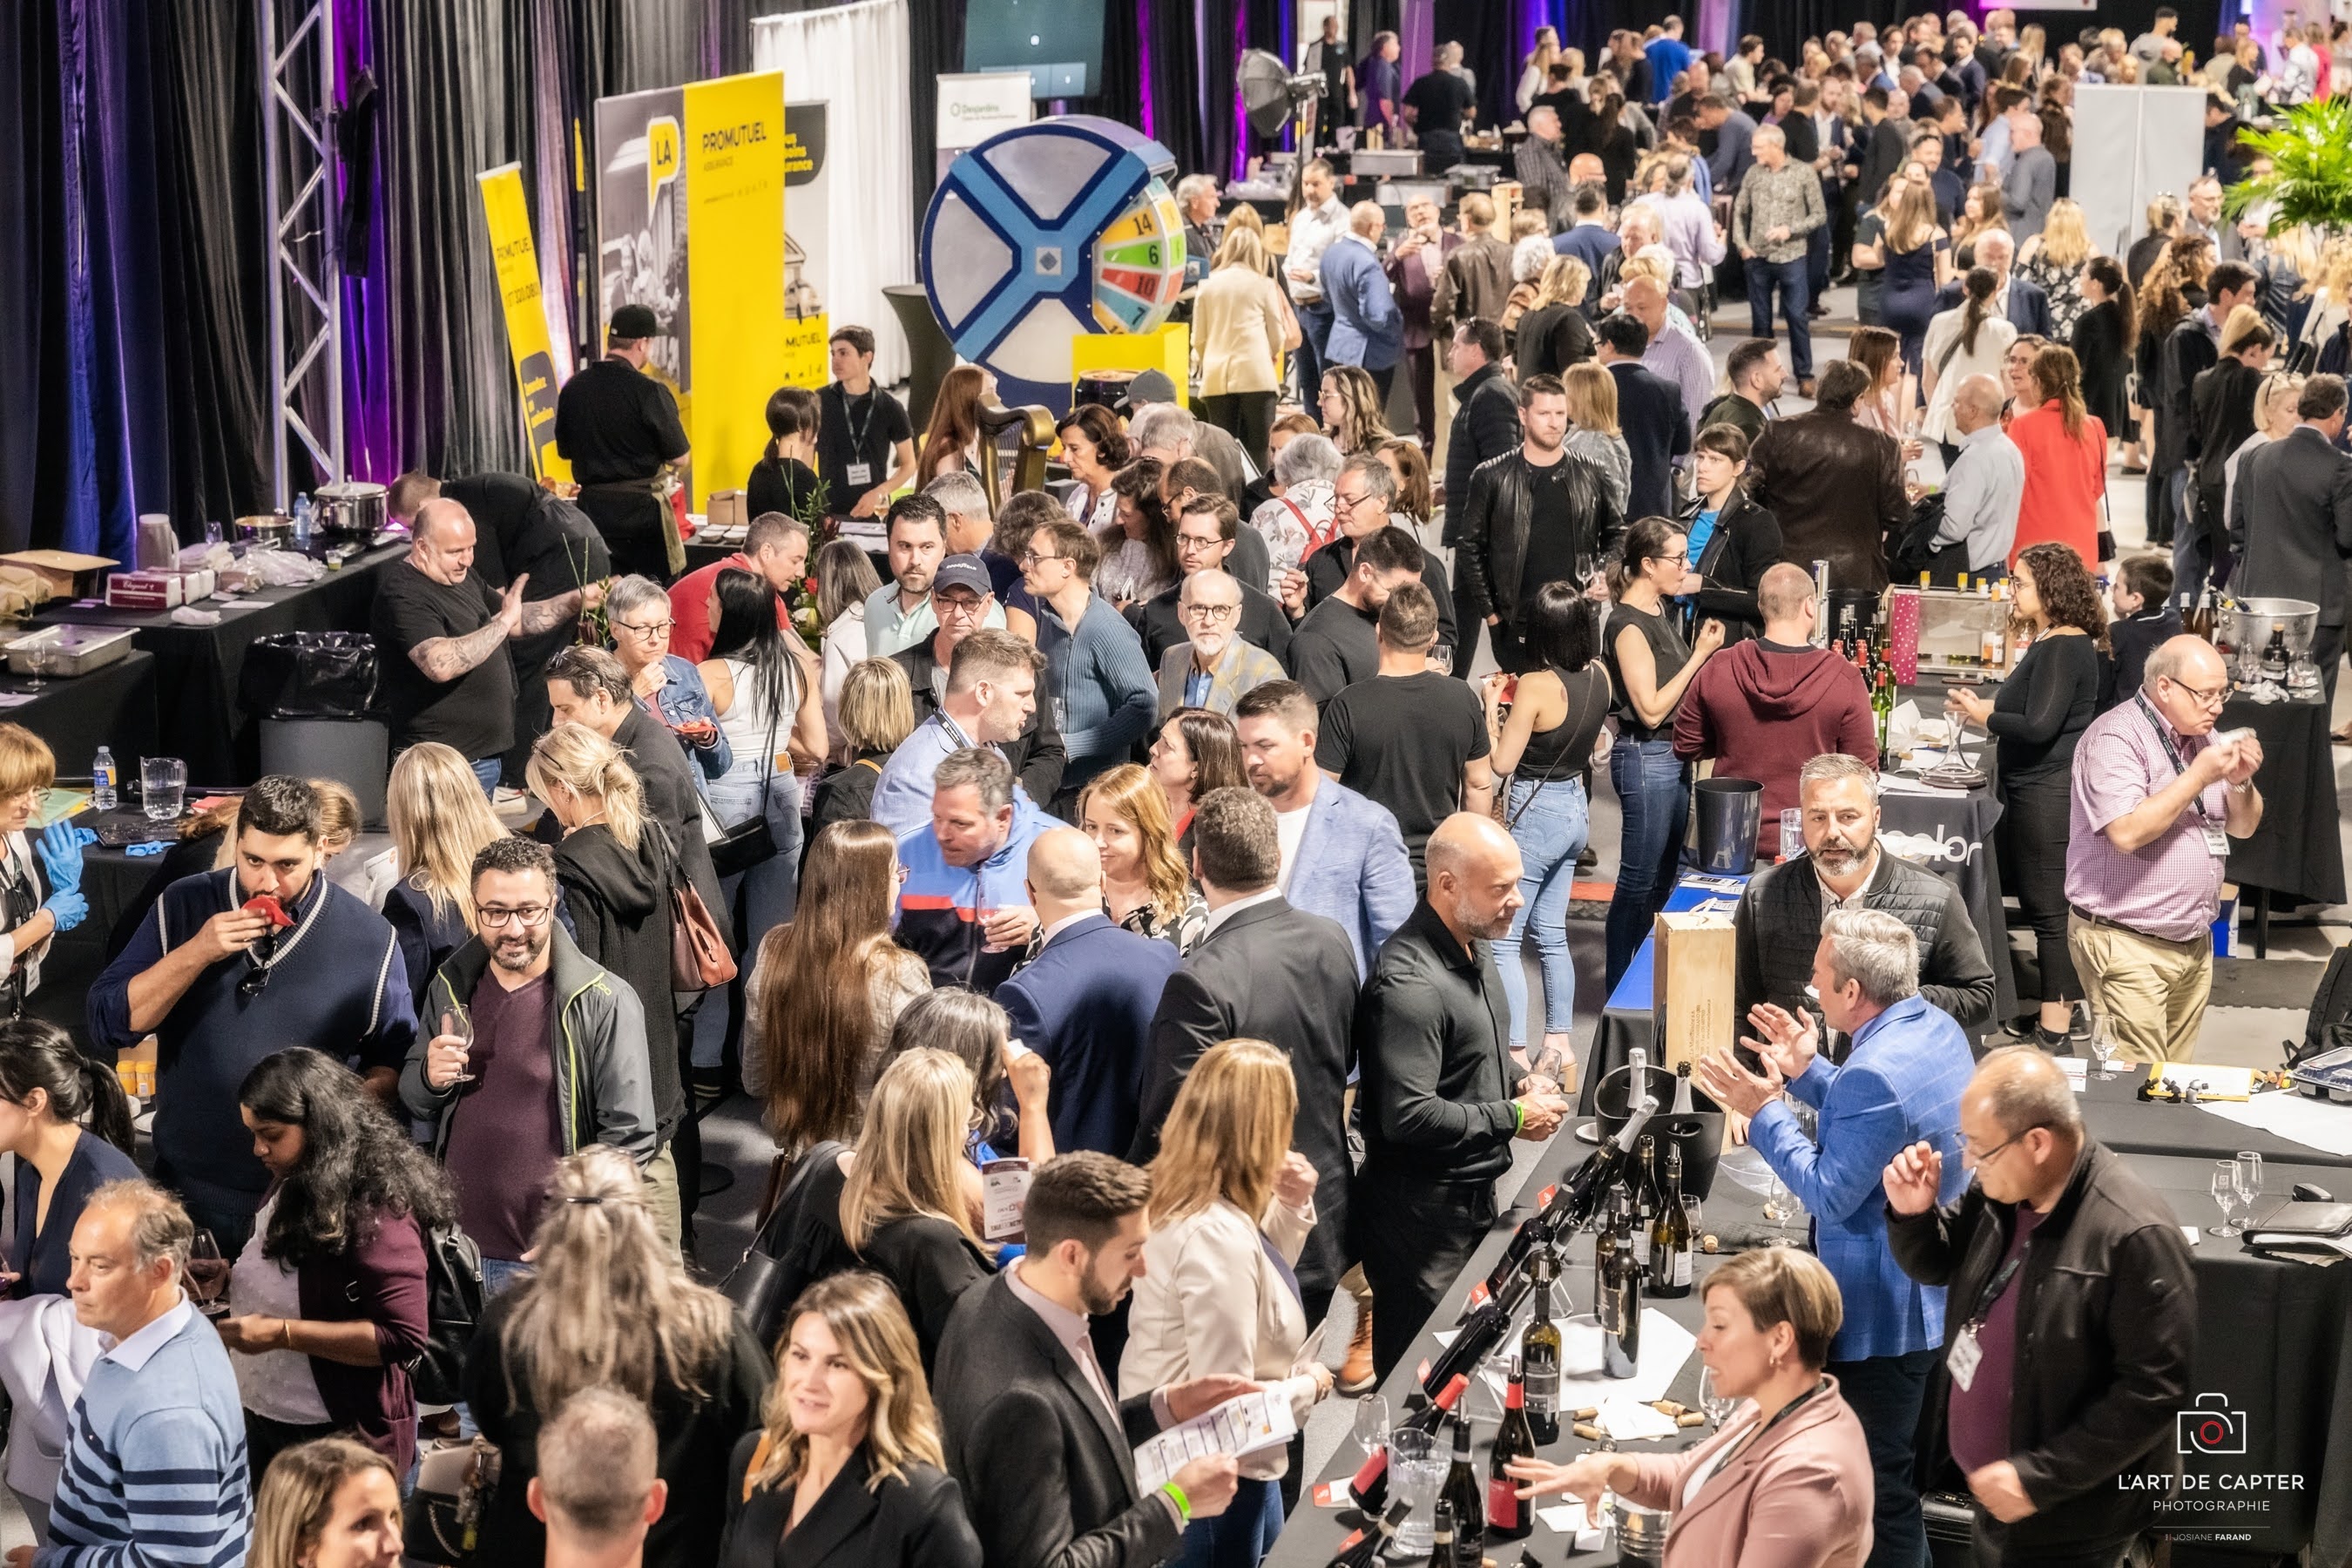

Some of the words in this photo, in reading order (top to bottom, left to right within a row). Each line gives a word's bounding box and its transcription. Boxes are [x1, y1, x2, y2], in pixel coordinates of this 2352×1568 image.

[656, 130, 672, 166] LÀ
[702, 121, 767, 153] PROMUTUEL
[1133, 213, 1152, 236] 14
[1148, 245, 1159, 265] 6
[1135, 275, 1156, 297] 10
[1131, 307, 1146, 326] 7
[786, 333, 821, 348] MUTUEL
